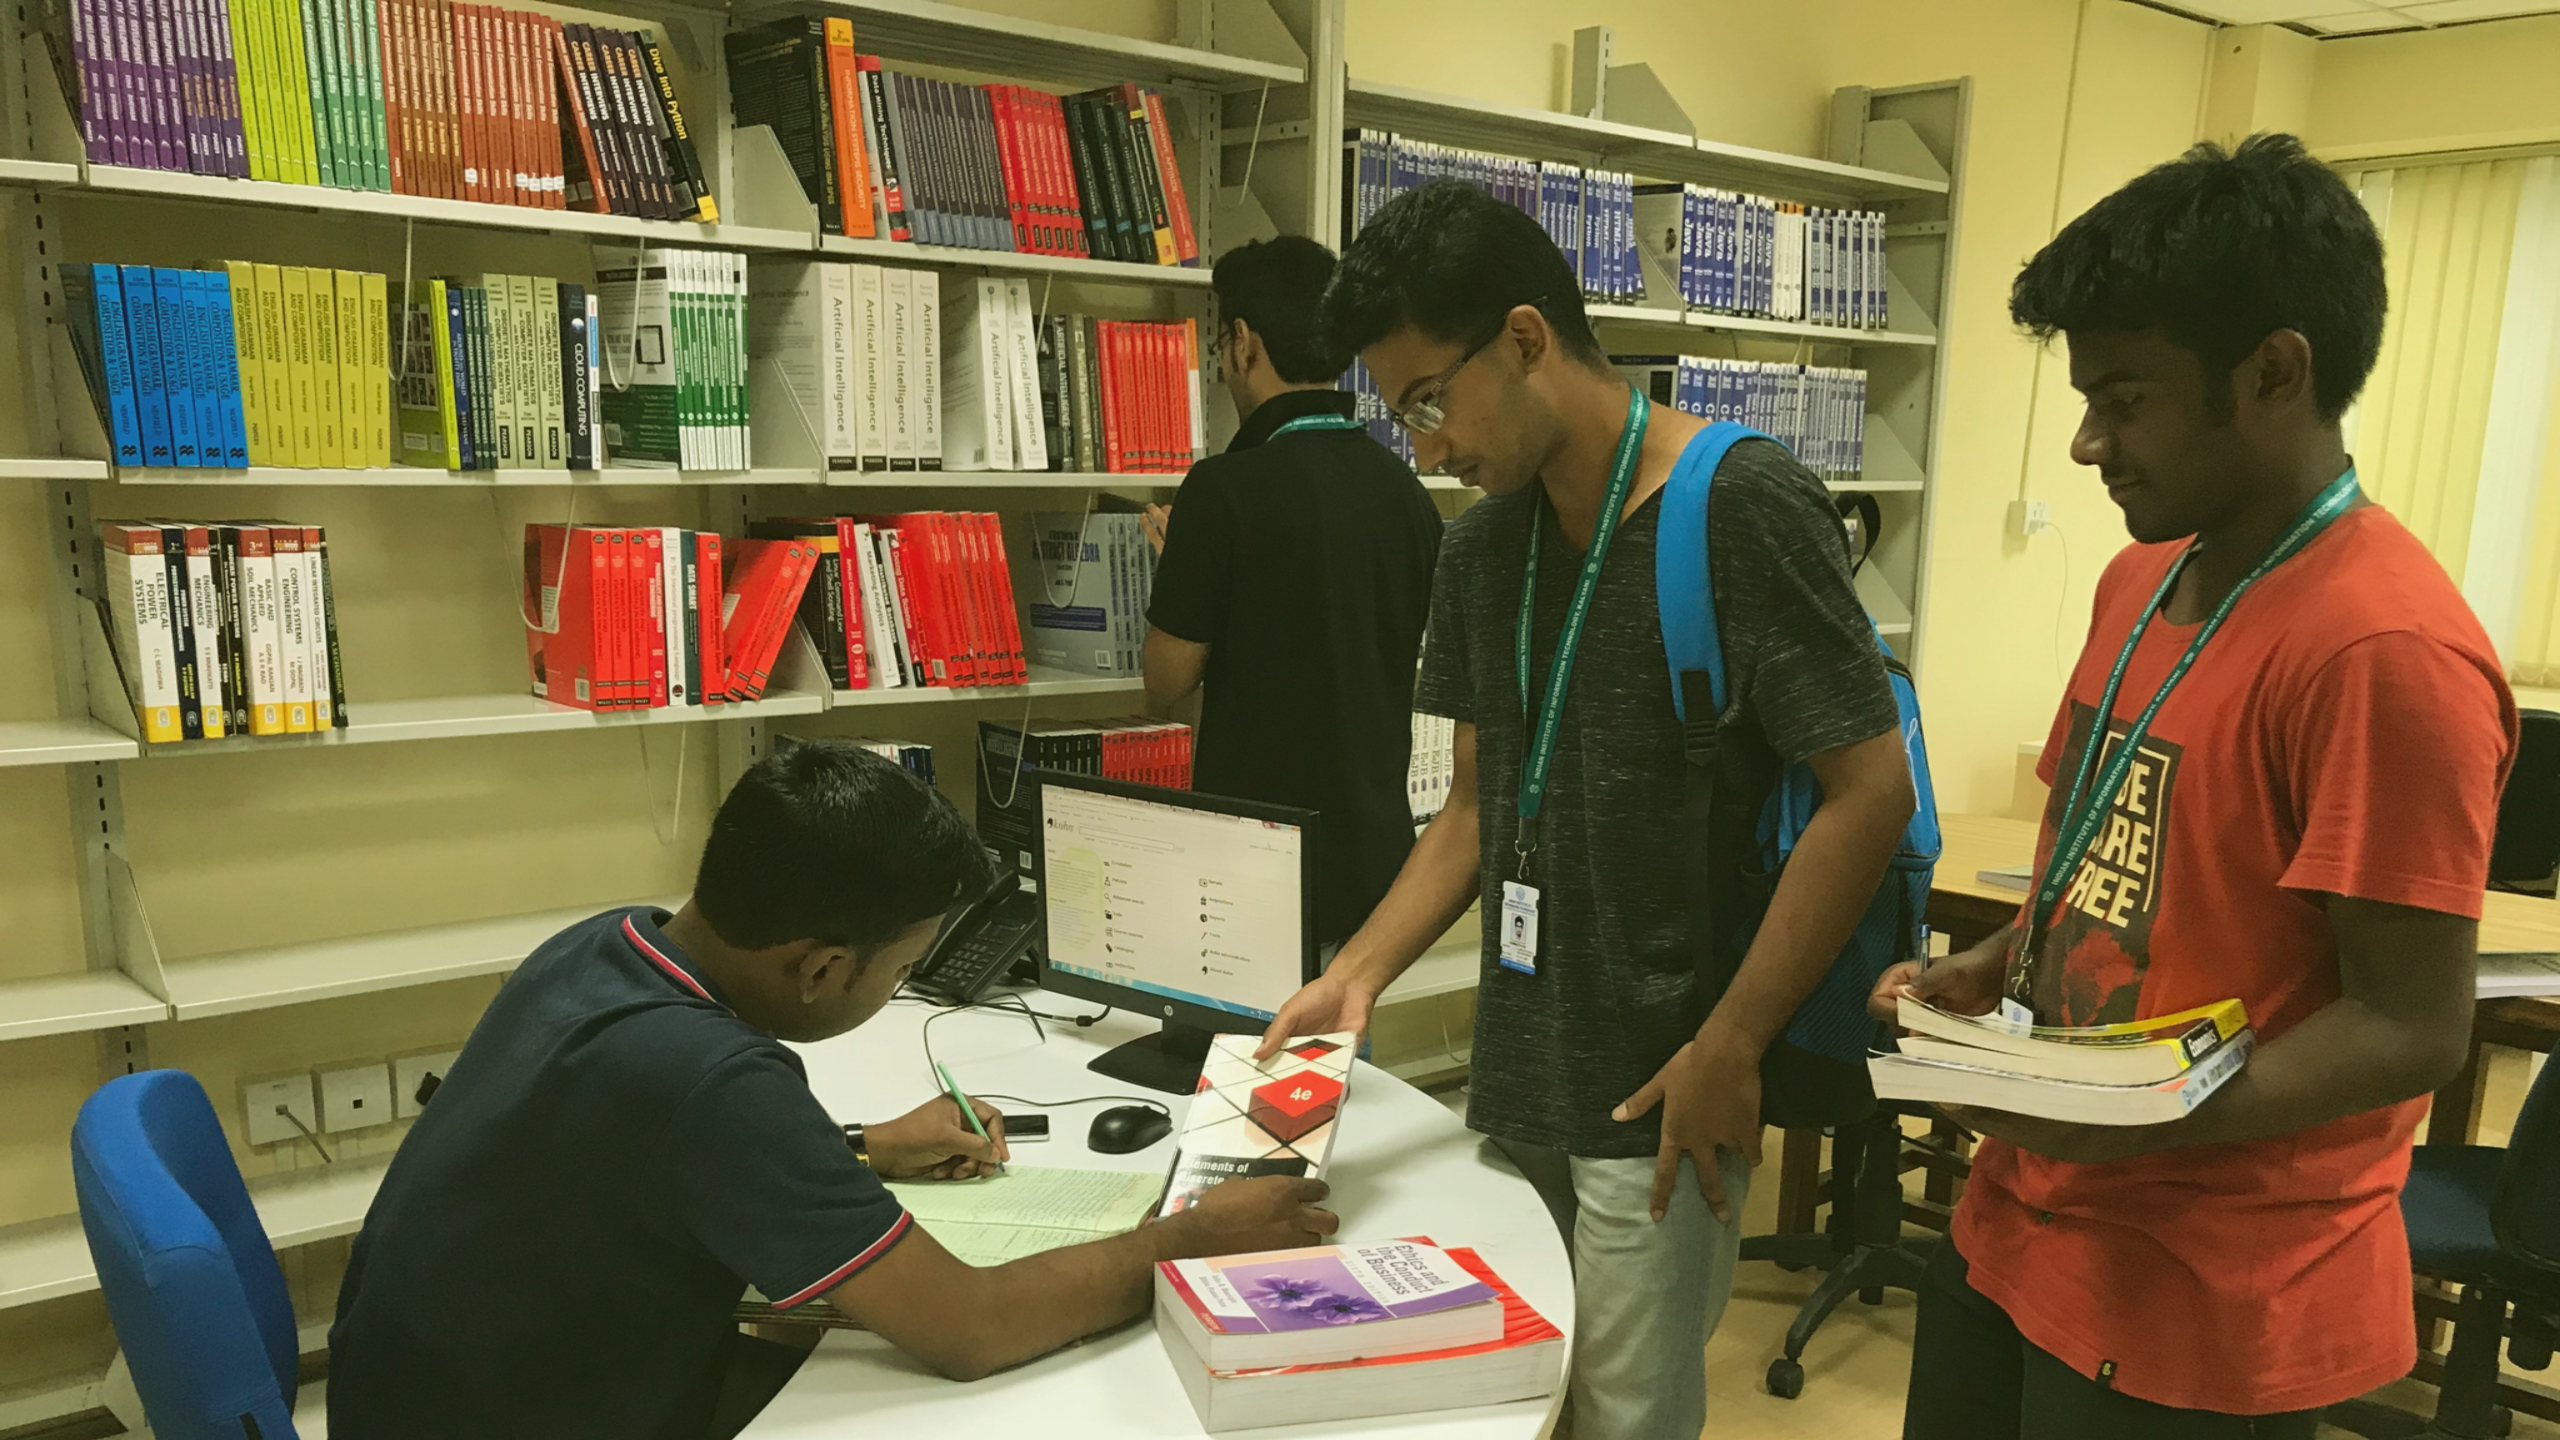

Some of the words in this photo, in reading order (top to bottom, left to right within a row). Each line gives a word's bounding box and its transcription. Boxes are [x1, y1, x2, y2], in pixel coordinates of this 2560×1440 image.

[571, 41, 584, 70] CAREER
[580, 72, 597, 120] INTERVIEWS
[602, 44, 614, 74] CAREER
[610, 75, 628, 123] INTERVIEWS
[628, 49, 641, 78] CAREER
[636, 79, 654, 126] INTERVIEWS
[650, 48, 664, 74] Dive
[659, 76, 672, 98] Into
[668, 100, 688, 140] Python
[844, 69, 856, 131] INFORMATION
[872, 75, 880, 93] Data
[875, 95, 884, 122] Mining
[852, 133, 862, 167] SYSTEMS
[879, 125, 892, 169] Techniques
[855, 170, 866, 209] SECURITY
[1683, 218, 1694, 255] Java
[1695, 222, 1704, 258] Java
[1705, 222, 1714, 258] Java
[1716, 226, 1725, 261] Java
[1744, 229, 1752, 264] Java
[111, 301, 125, 341] ENGLISH
[222, 308, 233, 348] ENGLISH
[237, 305, 247, 357] COMPOSITION
[246, 323, 255, 360] GRAMMAR
[519, 320, 527, 361] COMPUTER
[834, 297, 844, 354] Artificial
[866, 299, 876, 354] Artificial
[895, 302, 905, 358] Artificial
[924, 303, 933, 358] Artificial
[100, 294, 116, 356] COMPOSITION
[109, 366, 121, 396] USAGE
[211, 302, 225, 362] COMPOSITION
[218, 370, 230, 400] USAGE
[575, 343, 584, 376] CLOUD
[991, 332, 1001, 378] Artificial
[1056, 326, 1066, 370] ARTIFICIAL
[527, 349, 536, 404] MATHEMATICS
[834, 356, 845, 432] Intelligence
[867, 357, 877, 432] Intelligence
[895, 360, 906, 434] Intelligence
[1017, 334, 1030, 380] Artificial
[1024, 382, 1037, 446] Intelligence
[576, 378, 588, 436] COMPUTING
[924, 361, 934, 434] Intelligence
[994, 378, 1004, 446] Intelligence
[1060, 372, 1070, 427] INTELLIGENCE
[121, 404, 131, 435] NESFIELD
[230, 408, 238, 437] NESFIELD
[1594, 532, 1605, 557] INDIAN
[1601, 494, 1617, 531] INSTITUTE
[1616, 432, 1636, 481] INFORMATION
[246, 566, 254, 584] SOIL
[290, 568, 299, 606] CONTROL
[310, 557, 318, 578] LINEAR
[687, 564, 696, 582] DATA
[878, 564, 890, 605] Distributed
[135, 579, 148, 625] SYSTEMS
[146, 583, 158, 620] POWER
[156, 572, 170, 630] ELECTRICAL
[195, 578, 204, 626] MECHANICS
[203, 575, 212, 629] ENGINEERING
[248, 586, 258, 633] MECHANICS
[258, 584, 266, 616] APPLIED
[265, 579, 273, 603] BASIC
[282, 578, 292, 634] ENGINEERING
[312, 579, 320, 615] INTEGRATED
[688, 585, 697, 609] SMART
[827, 592, 835, 622] Scripting
[867, 551, 879, 590] Marketing
[873, 592, 884, 627] Analytics
[893, 551, 901, 576] Doing
[898, 578, 906, 596] Data
[902, 598, 912, 629] Science
[294, 608, 303, 644] SYSTEMS
[314, 617, 322, 643] CIRCUITS
[671, 610, 679, 651] programming
[154, 660, 163, 690] WADHWA
[1534, 756, 1545, 779] INDIAN
[1541, 720, 1553, 756] INSTITUTE
[1547, 708, 1555, 718] OF
[1553, 660, 1567, 708] INFORMATION
[1576, 579, 1590, 610] KALYANI
[1054, 819, 1074, 832] koha
[2052, 862, 2071, 885] INDIAN
[2067, 820, 2092, 860] INSTITUTE
[2088, 808, 2098, 820] OF
[2095, 756, 2127, 805] INFORMATION
[2066, 858, 2141, 928] REE
[2187, 1027, 2217, 1058] Economics
[1289, 1087, 1313, 1101] 4e
[1237, 1162, 1250, 1173] of
[1357, 1249, 1378, 1257] of
[1376, 1246, 1394, 1260] the
[1390, 1261, 1434, 1293] Conduct
[1394, 1245, 1428, 1271] Ethics
[1420, 1271, 1450, 1286] and
[1366, 1258, 1410, 1295] Business
